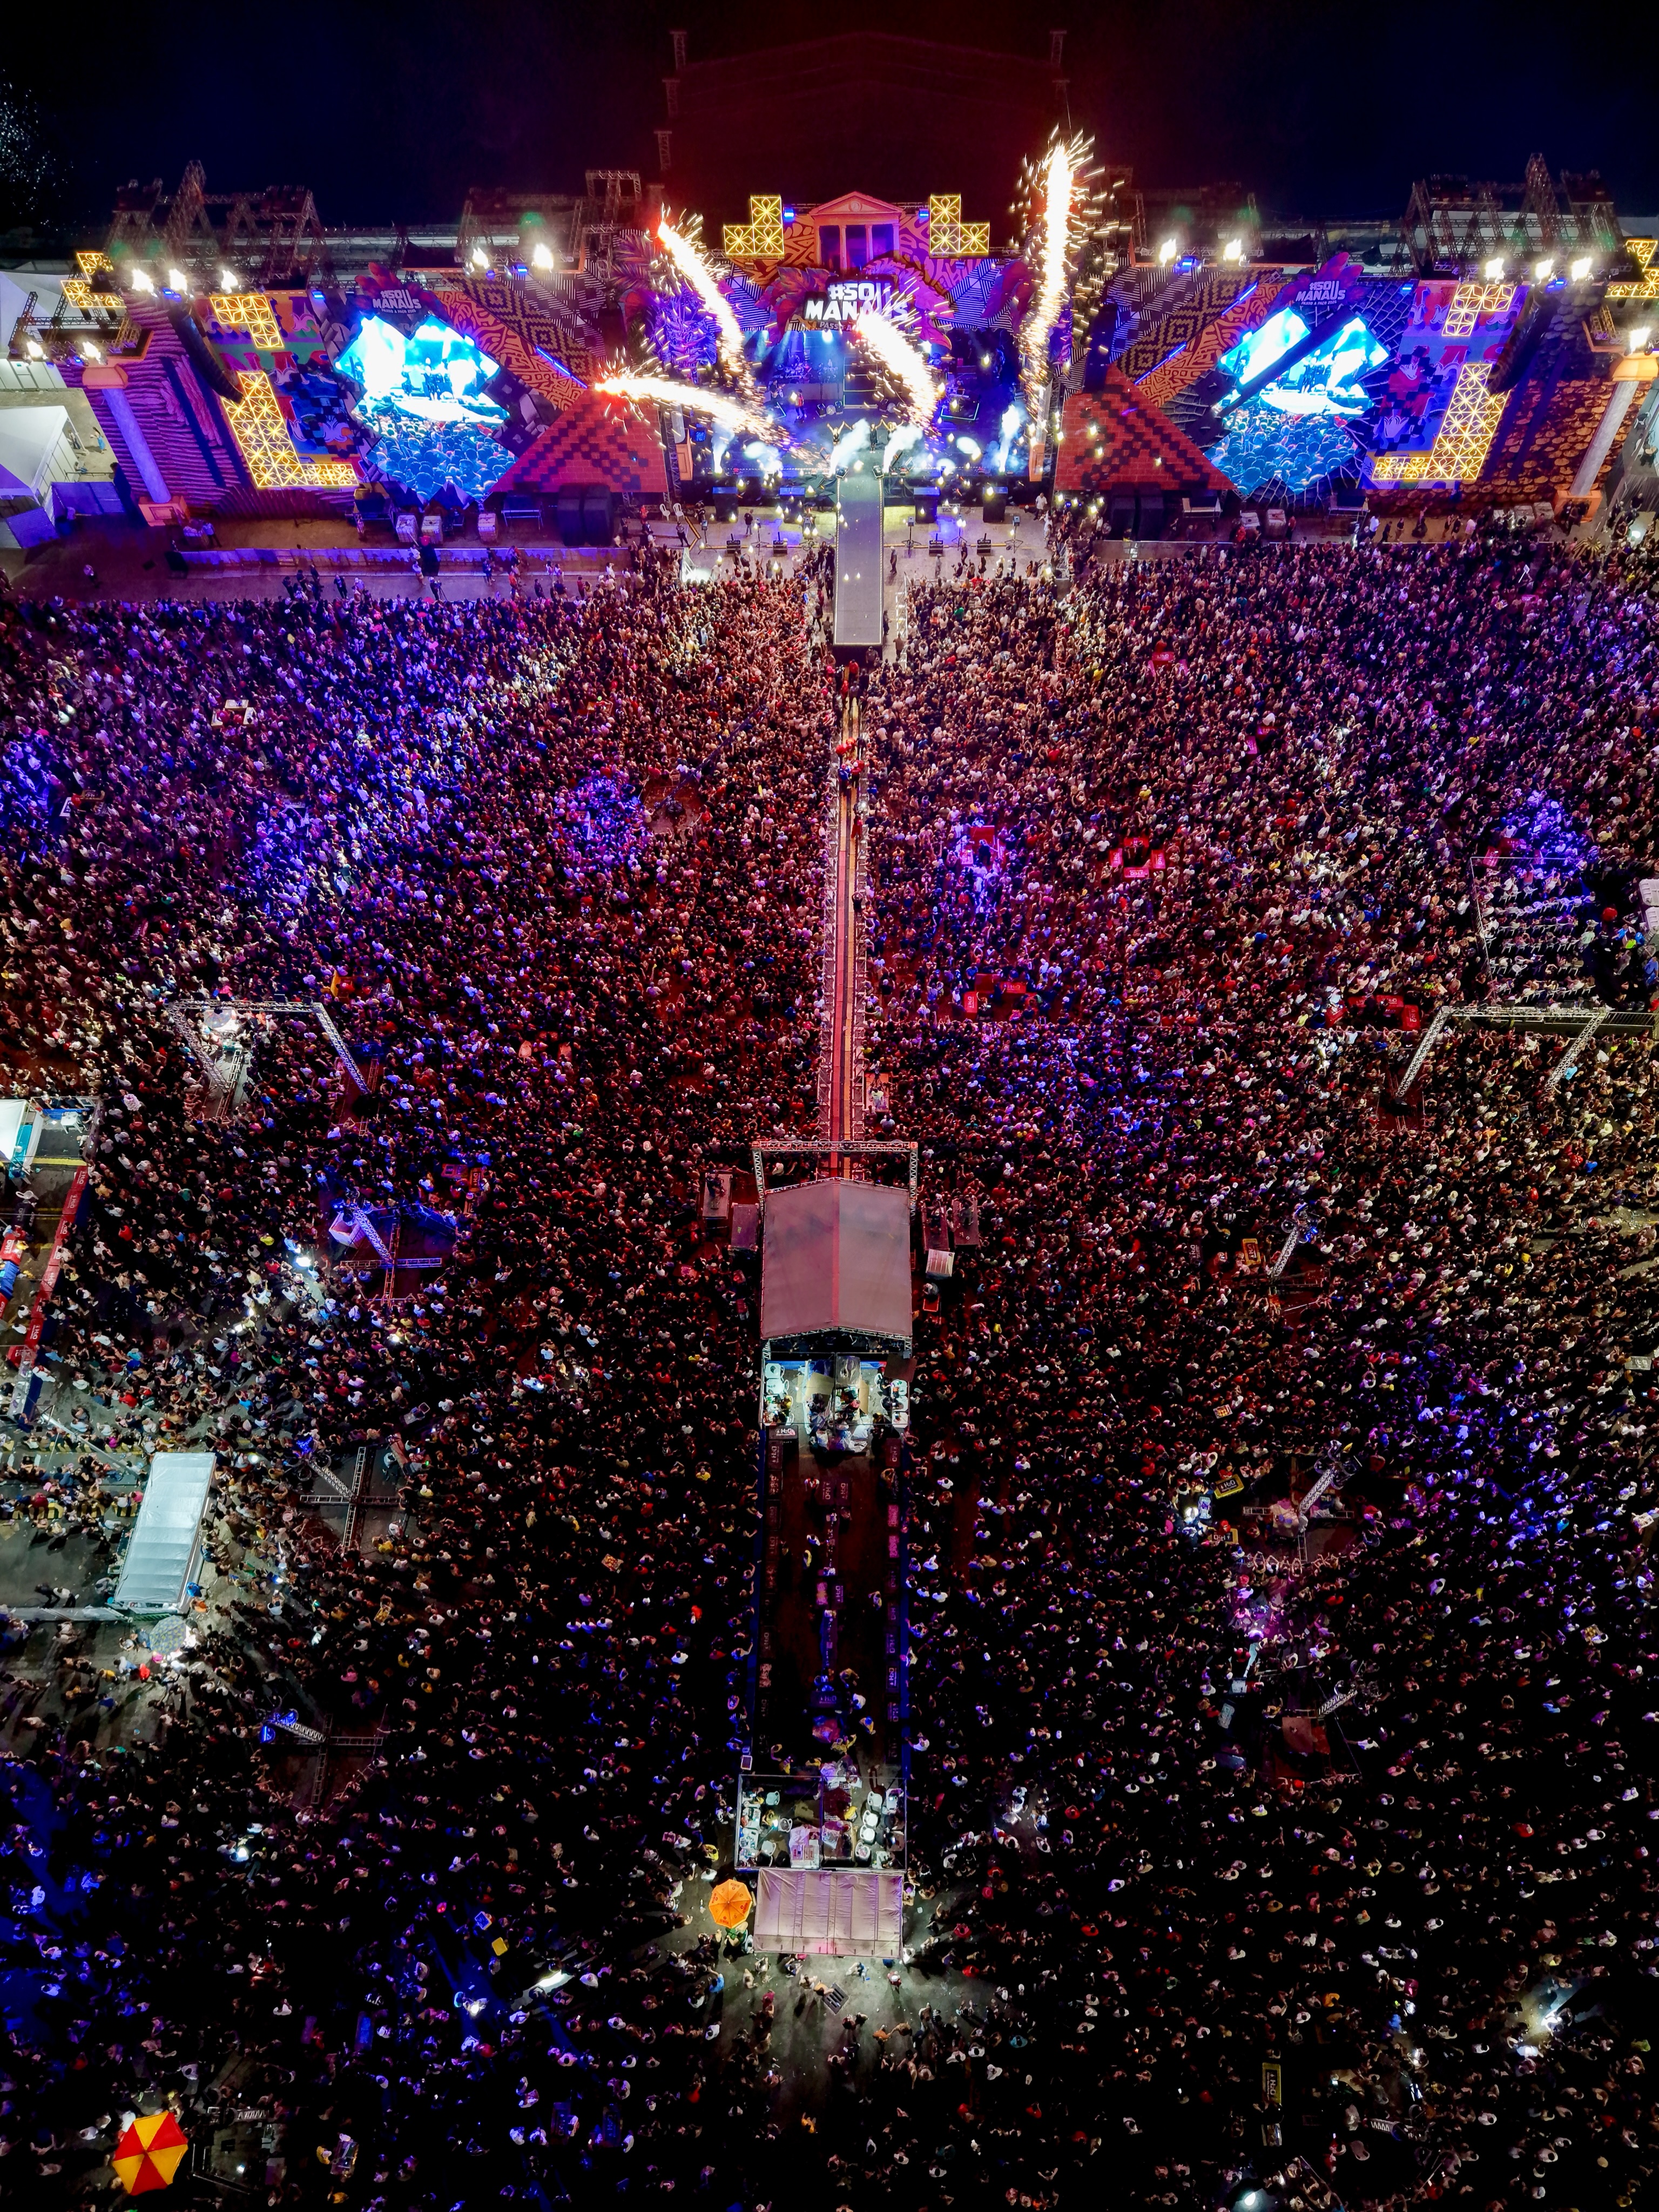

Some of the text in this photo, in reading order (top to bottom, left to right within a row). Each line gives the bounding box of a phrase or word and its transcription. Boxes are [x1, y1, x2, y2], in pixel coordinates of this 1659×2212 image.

[1309, 280, 1339, 291] #SOU
[380, 289, 410, 299] #SOU
[1296, 289, 1346, 301] MANAUS
[373, 299, 422, 309] MANAUS
[1224, 1480, 1236, 1488] H2O
